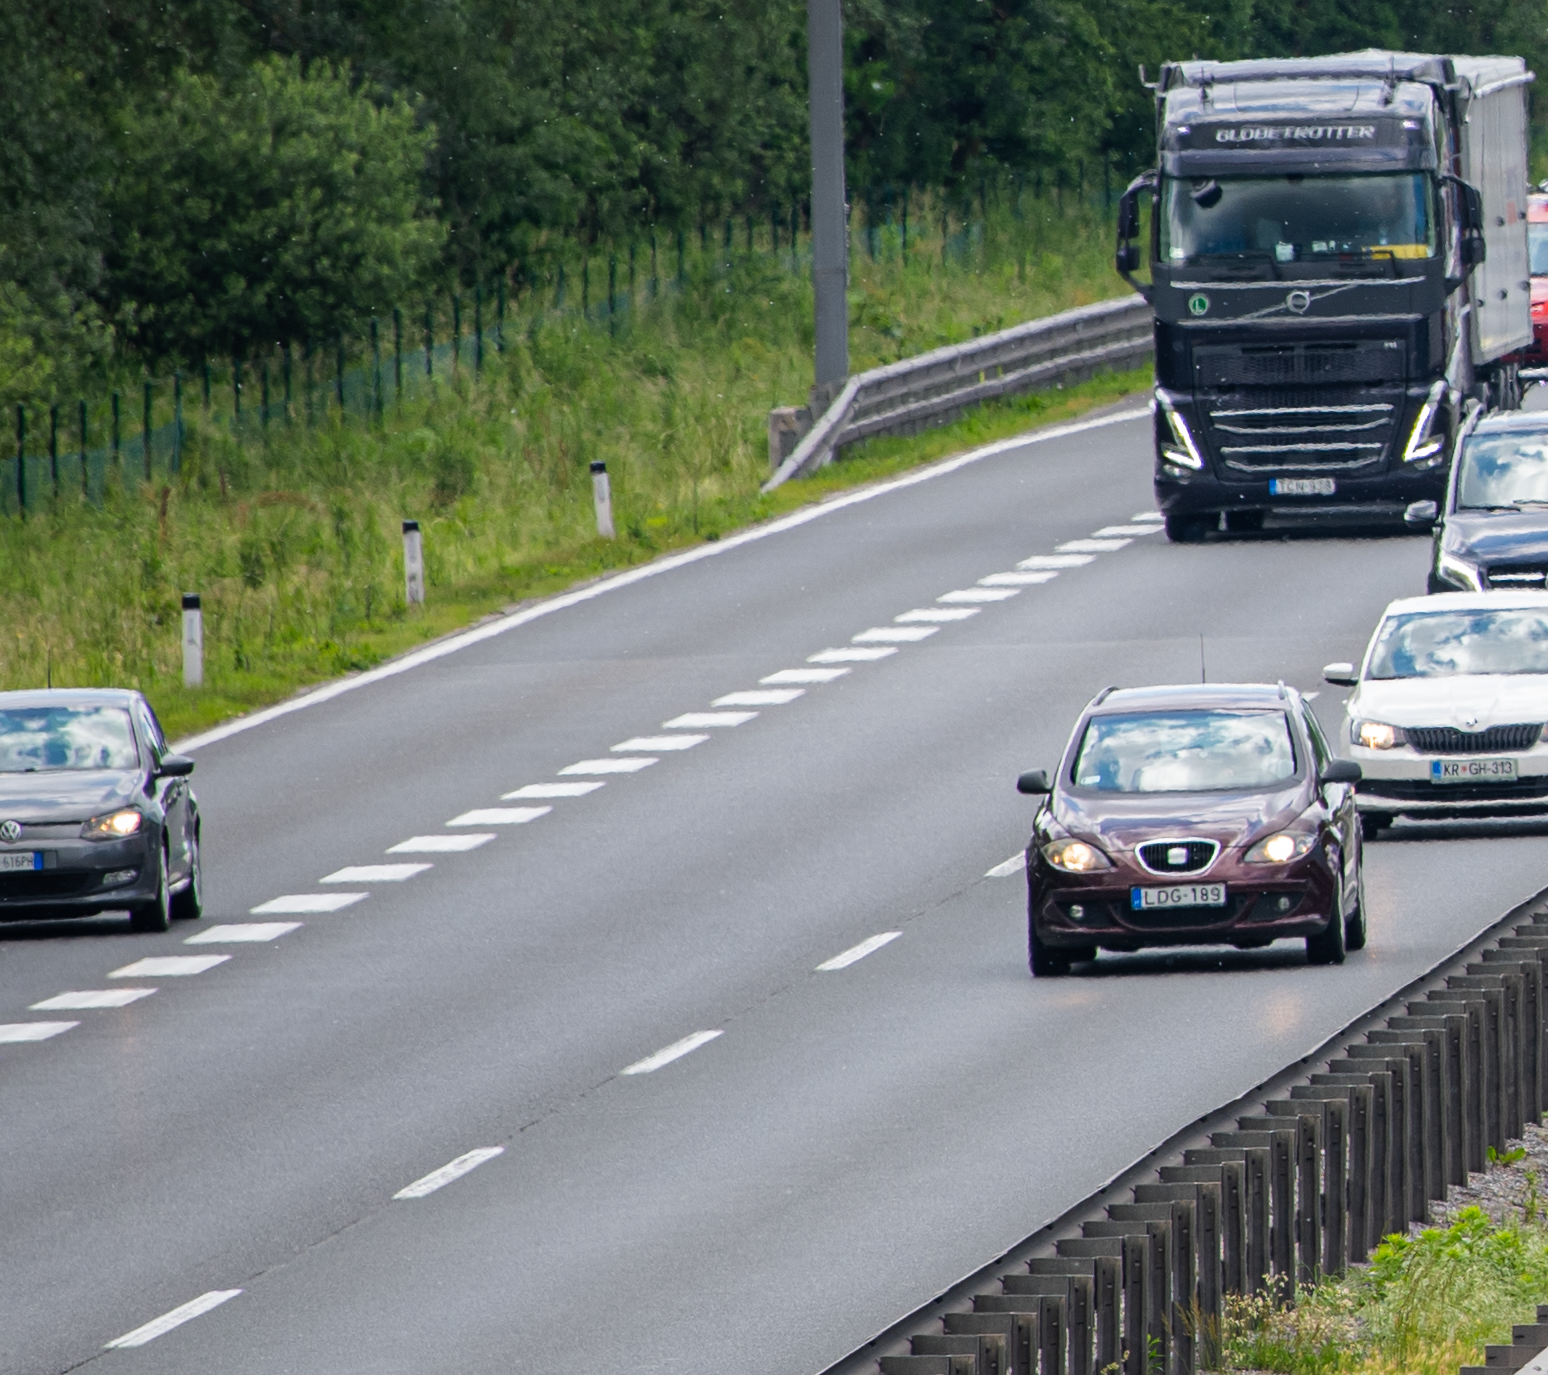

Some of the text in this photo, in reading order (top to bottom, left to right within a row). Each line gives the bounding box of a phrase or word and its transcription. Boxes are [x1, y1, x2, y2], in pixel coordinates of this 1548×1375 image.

[1444, 761, 1512, 776] KR GH-313
[1144, 886, 1221, 906] LDG-189
